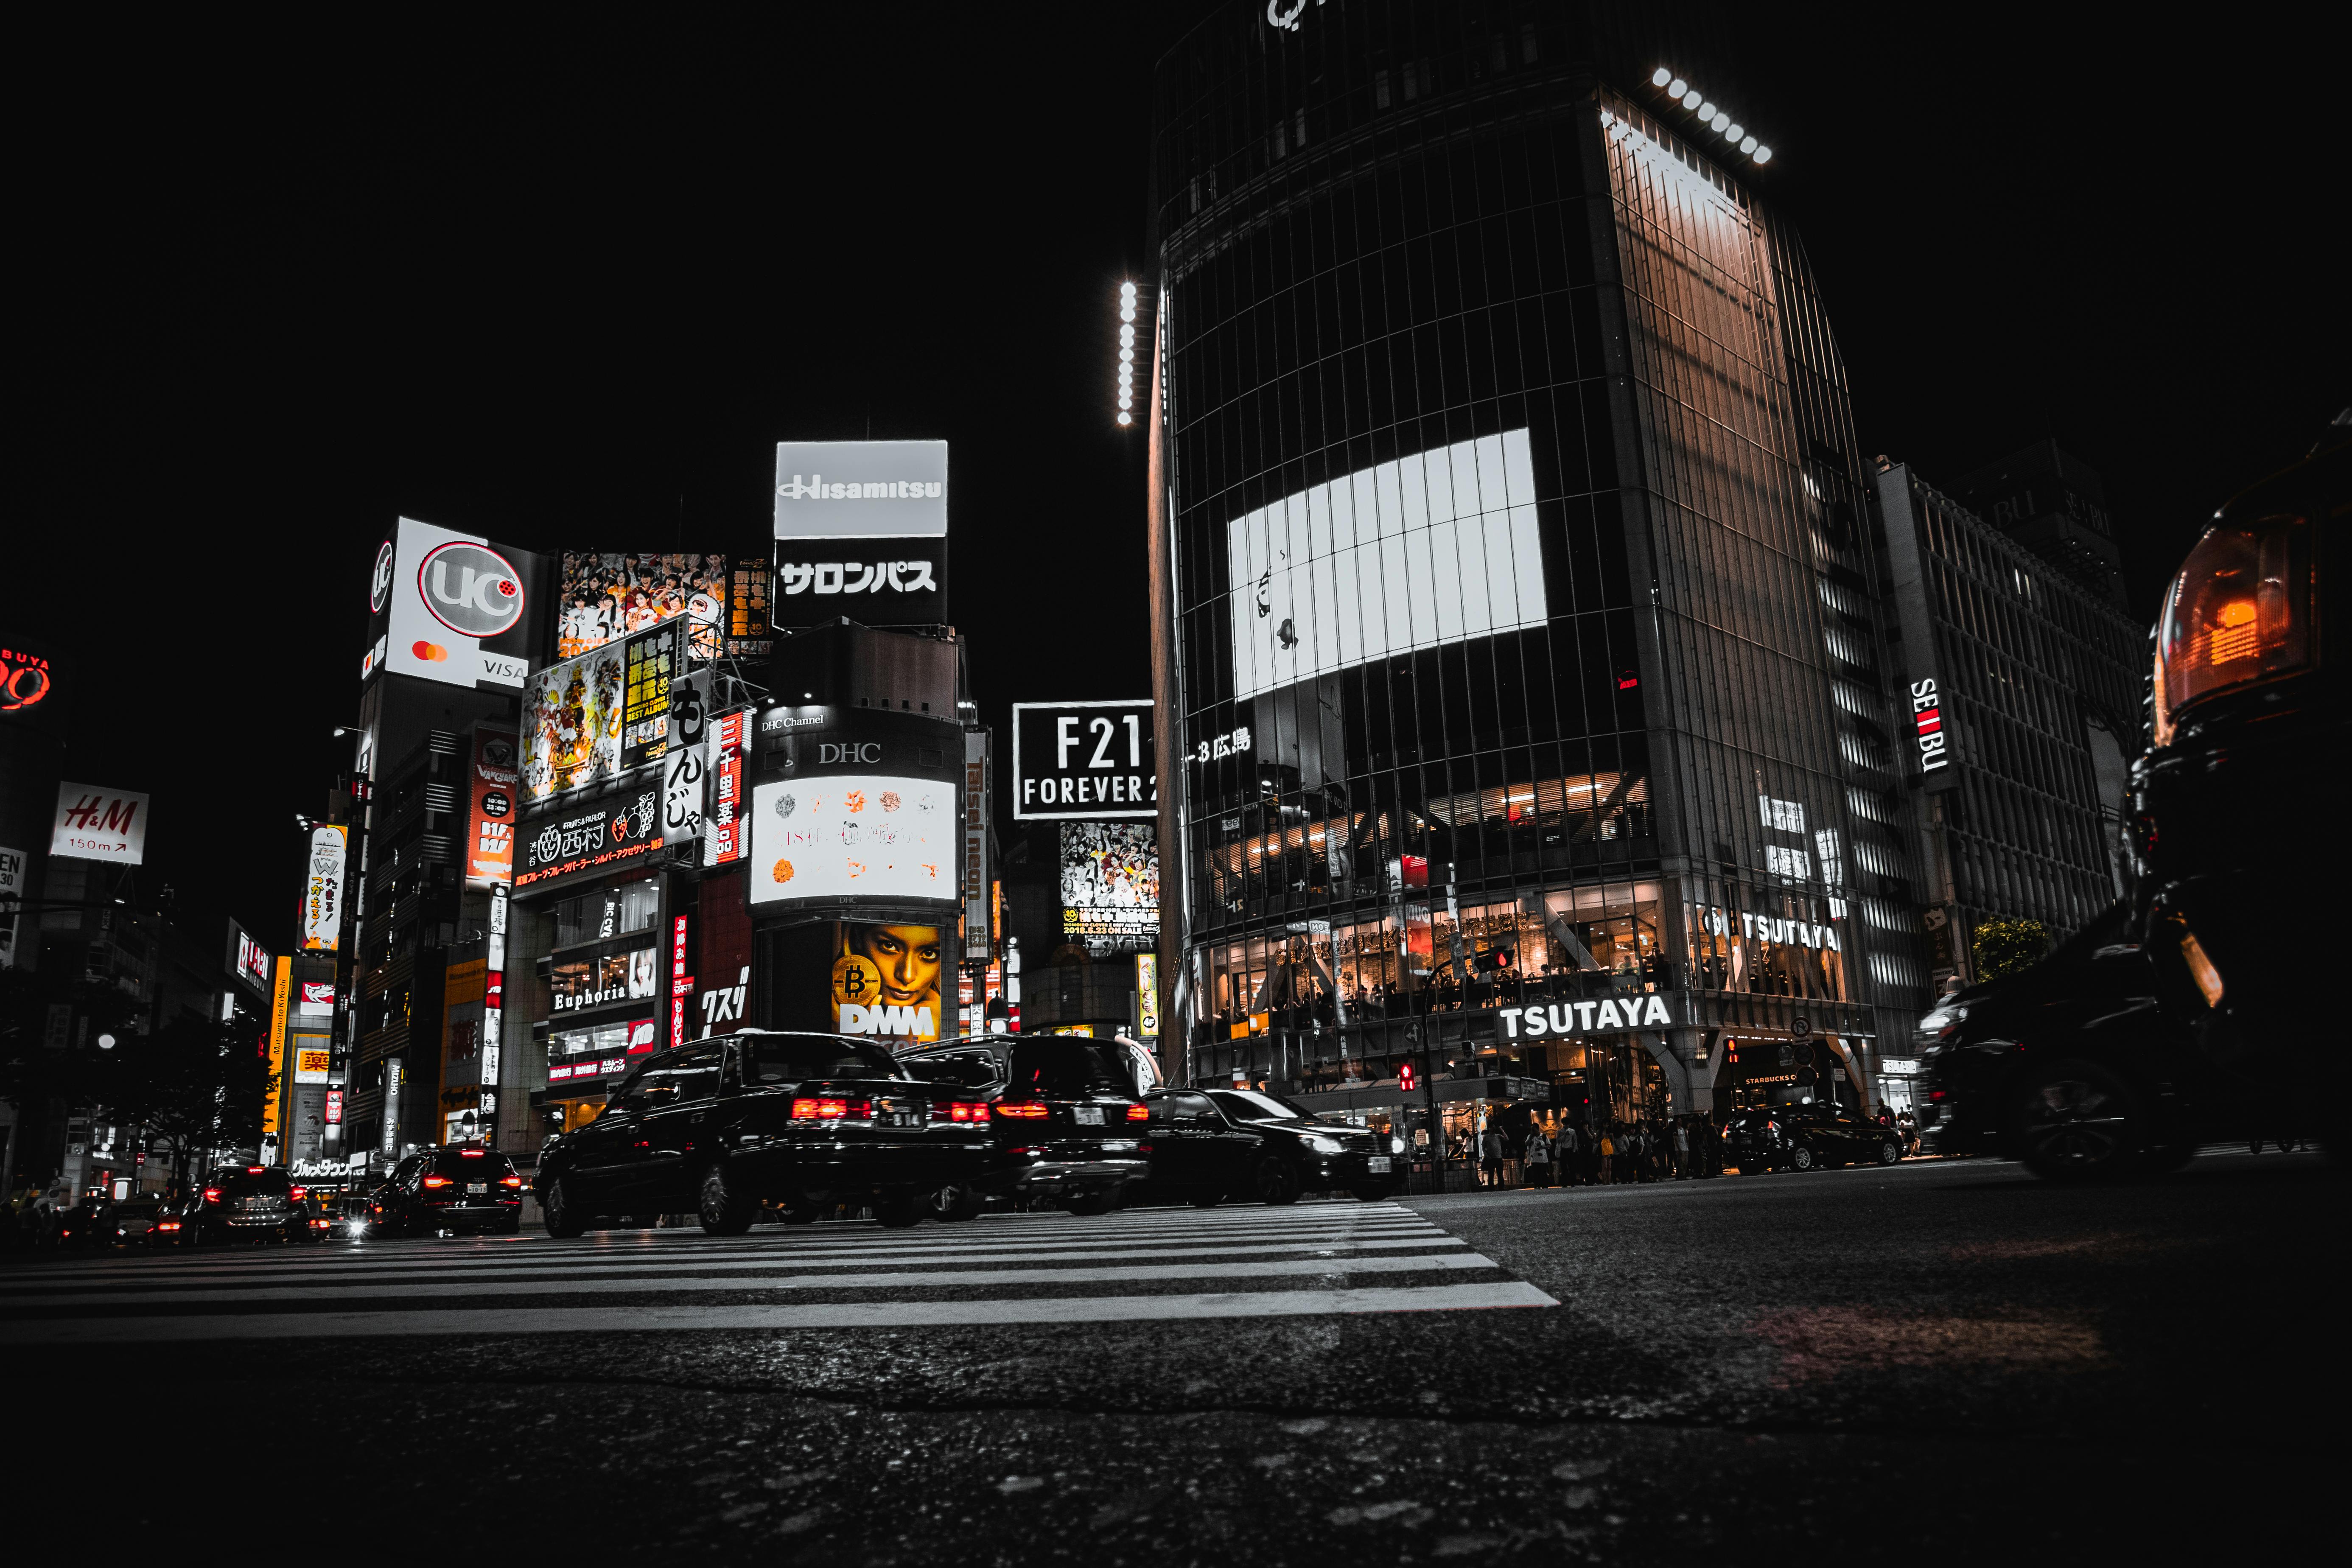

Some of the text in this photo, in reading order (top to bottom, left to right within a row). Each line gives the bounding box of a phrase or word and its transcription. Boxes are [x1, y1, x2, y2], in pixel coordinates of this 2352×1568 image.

[777, 474, 941, 499] Hisamitsu
[781, 561, 936, 595] サロンパス
[484, 659, 525, 679] VISA
[627, 701, 669, 722] BEST ALBUM
[649, 697, 666, 707] CLOVER
[762, 714, 823, 732] DHC Channel
[819, 743, 881, 764] DHC
[1058, 715, 1140, 769] F21
[668, 678, 705, 835] もんじゃ
[716, 719, 736, 854] 三千里薬品
[1025, 776, 1142, 804] FOREVER
[64, 794, 138, 836] H&M
[481, 821, 509, 837] B1F
[562, 823, 605, 858] 西村
[69, 838, 110, 852] 150m
[529, 842, 537, 867] 渋谷
[966, 838, 982, 901] neon
[1742, 913, 1841, 952] TSUTAYA
[554, 986, 626, 1011] Euphoria
[840, 1003, 935, 1036] DMM
[1143, 1017, 1155, 1027] 4F
[1500, 996, 1671, 1037] TSUTAYA
[273, 1009, 285, 1055] Matsumoto
[305, 1052, 328, 1070] 薬
[602, 1059, 624, 1067] ハネムーン
[1884, 1061, 1917, 1073] TSUTAYA
[391, 1065, 400, 1096] MIZUHO
[1746, 1075, 1789, 1084] STARBUCKS
[293, 1157, 350, 1177] グルメタウン
